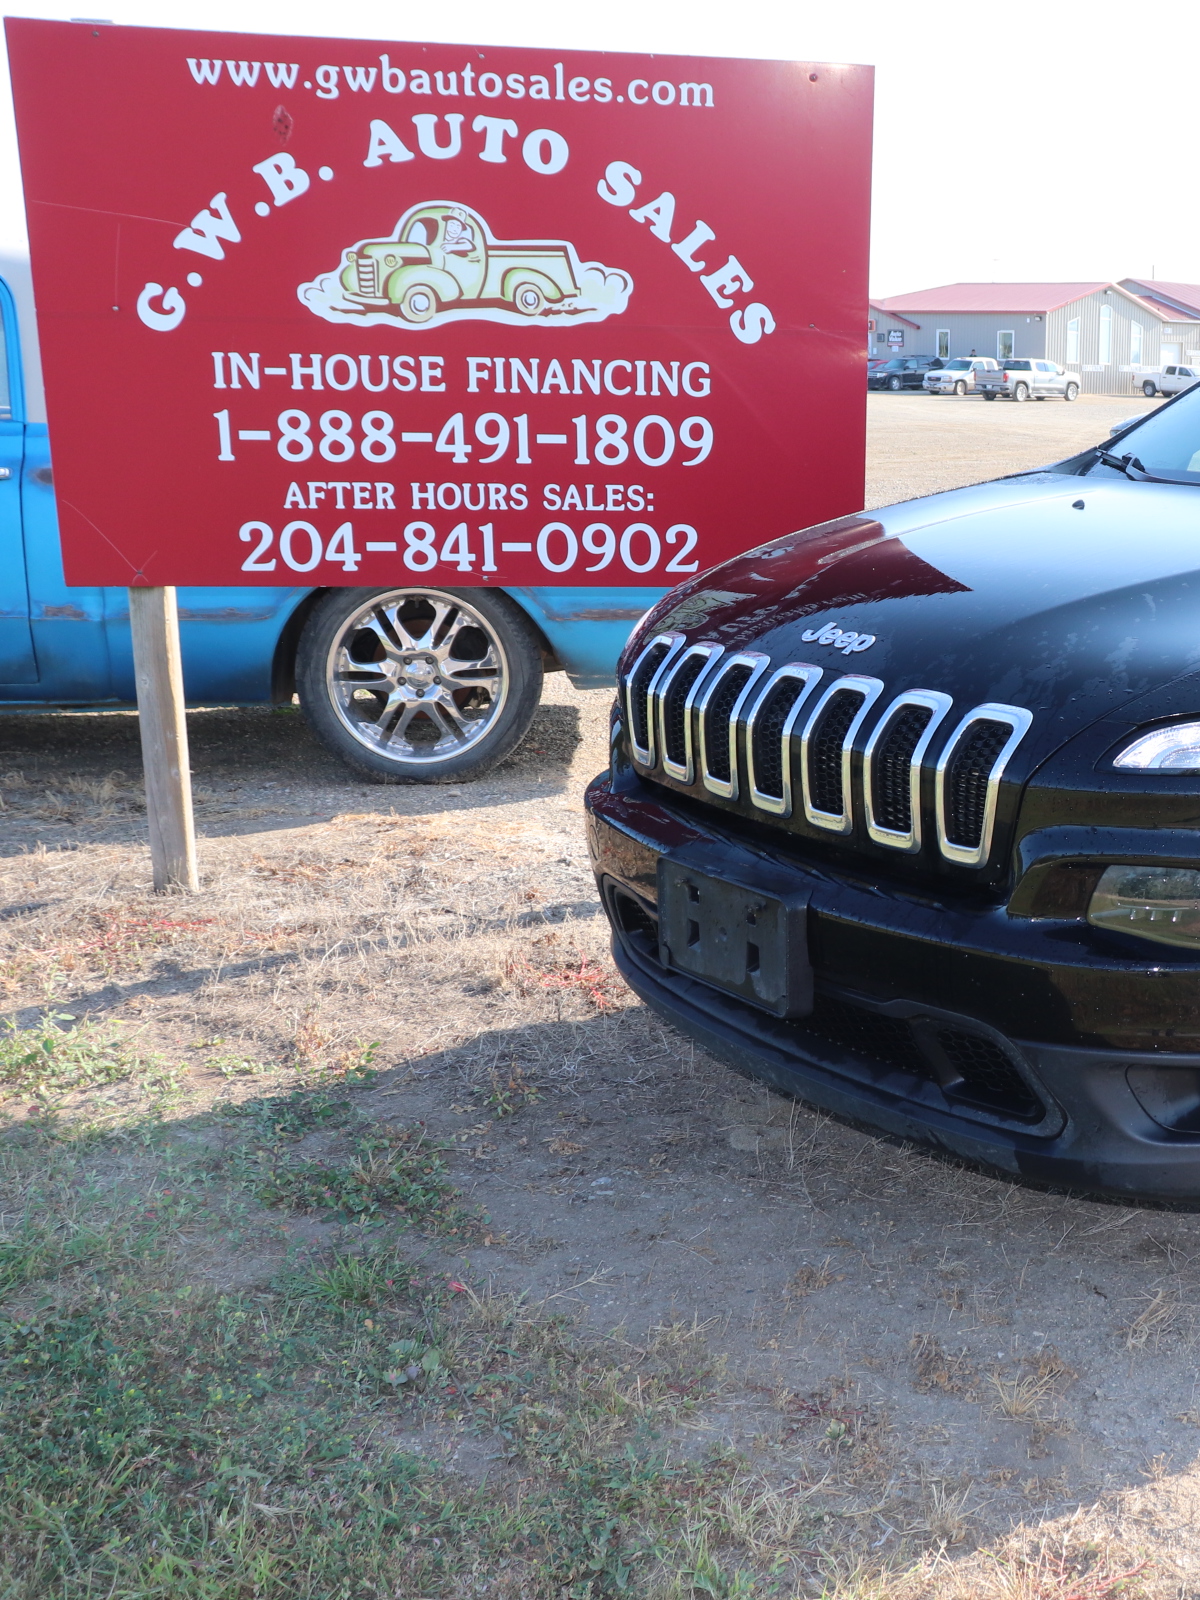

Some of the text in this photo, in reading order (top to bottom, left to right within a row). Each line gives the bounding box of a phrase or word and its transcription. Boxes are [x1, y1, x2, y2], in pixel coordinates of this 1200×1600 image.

[185, 53, 716, 109] www.gwbautosales.com
[136, 112, 777, 345] G.W.B. AUTO SALES
[211, 351, 713, 398] IN-HOUSE FINANCING
[213, 408, 715, 468] 1-888-491-1809
[283, 481, 655, 513] AFTER HOURS SALES:
[238, 520, 700, 575] 204-841-0902
[801, 621, 877, 656] Jeep
